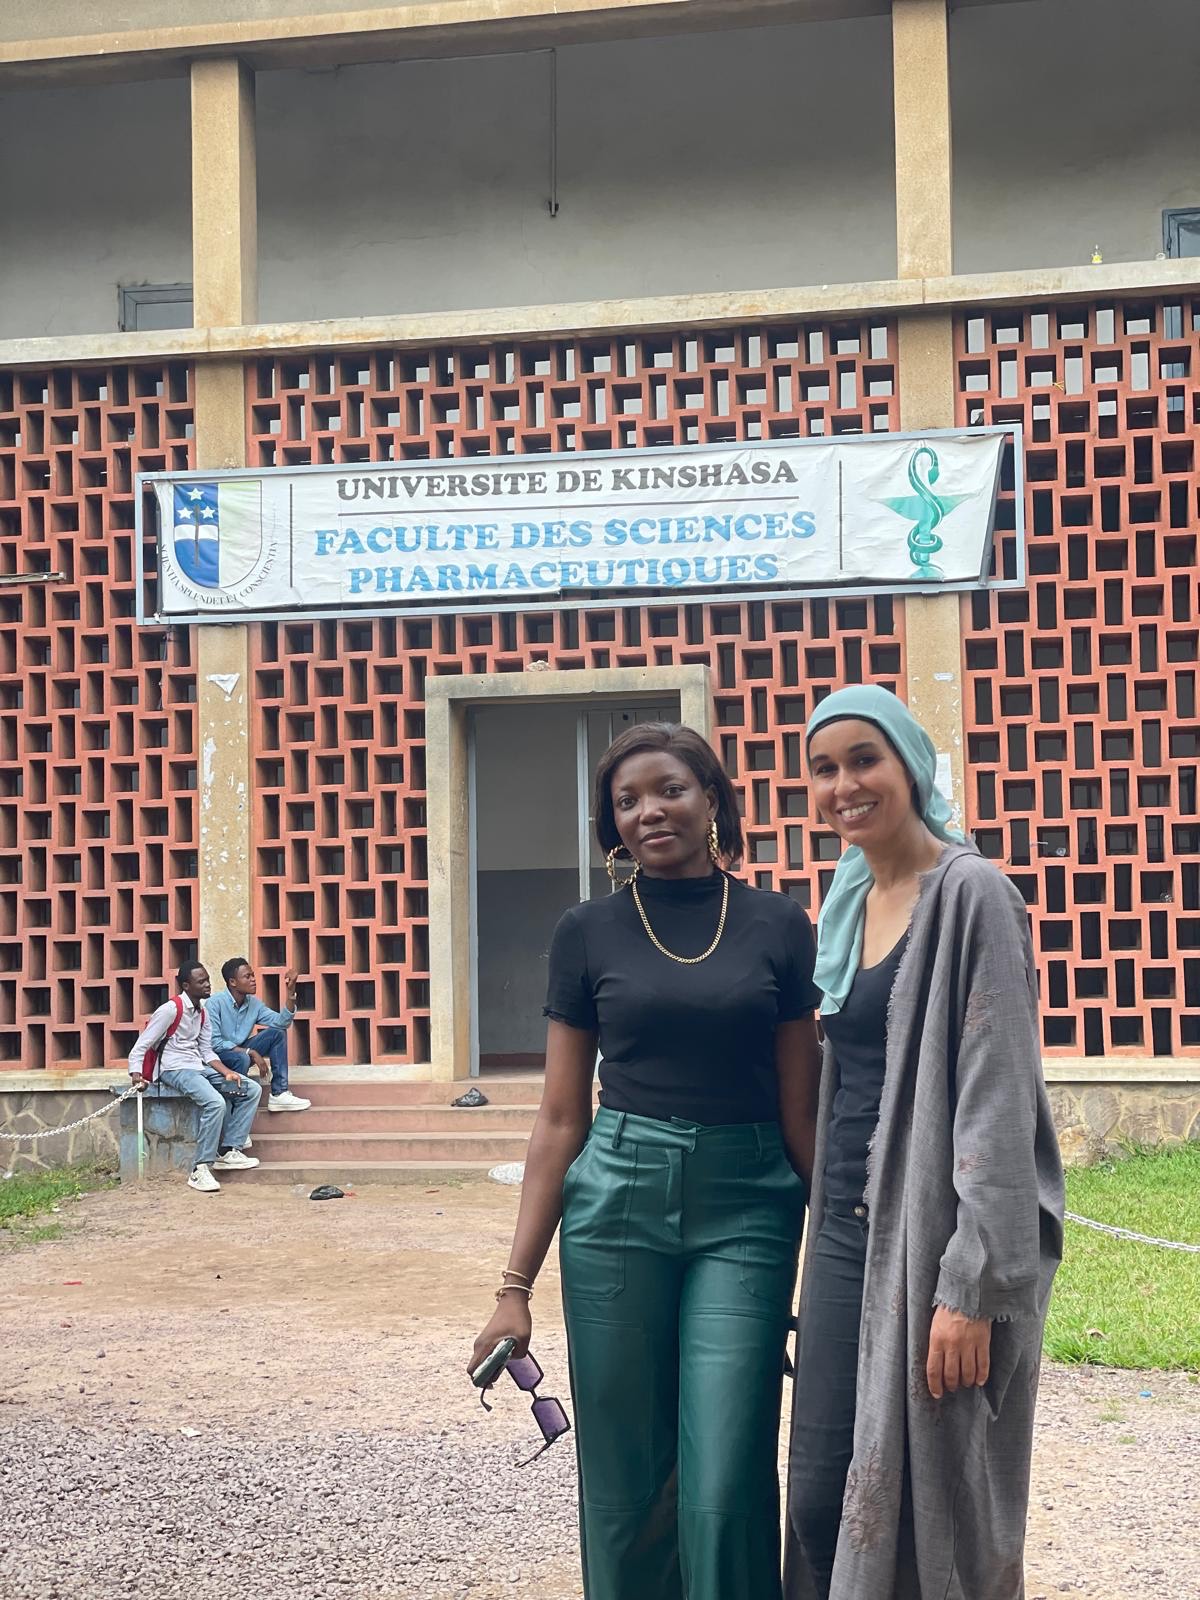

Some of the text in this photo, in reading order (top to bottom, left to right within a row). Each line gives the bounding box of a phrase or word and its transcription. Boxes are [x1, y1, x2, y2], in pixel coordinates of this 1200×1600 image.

[337, 460, 799, 501] UNIVERSITE DE KINSHASA
[314, 512, 816, 555] FACULTE DES SCIENCES
[348, 554, 778, 593] PHARMACEUTIQUES
